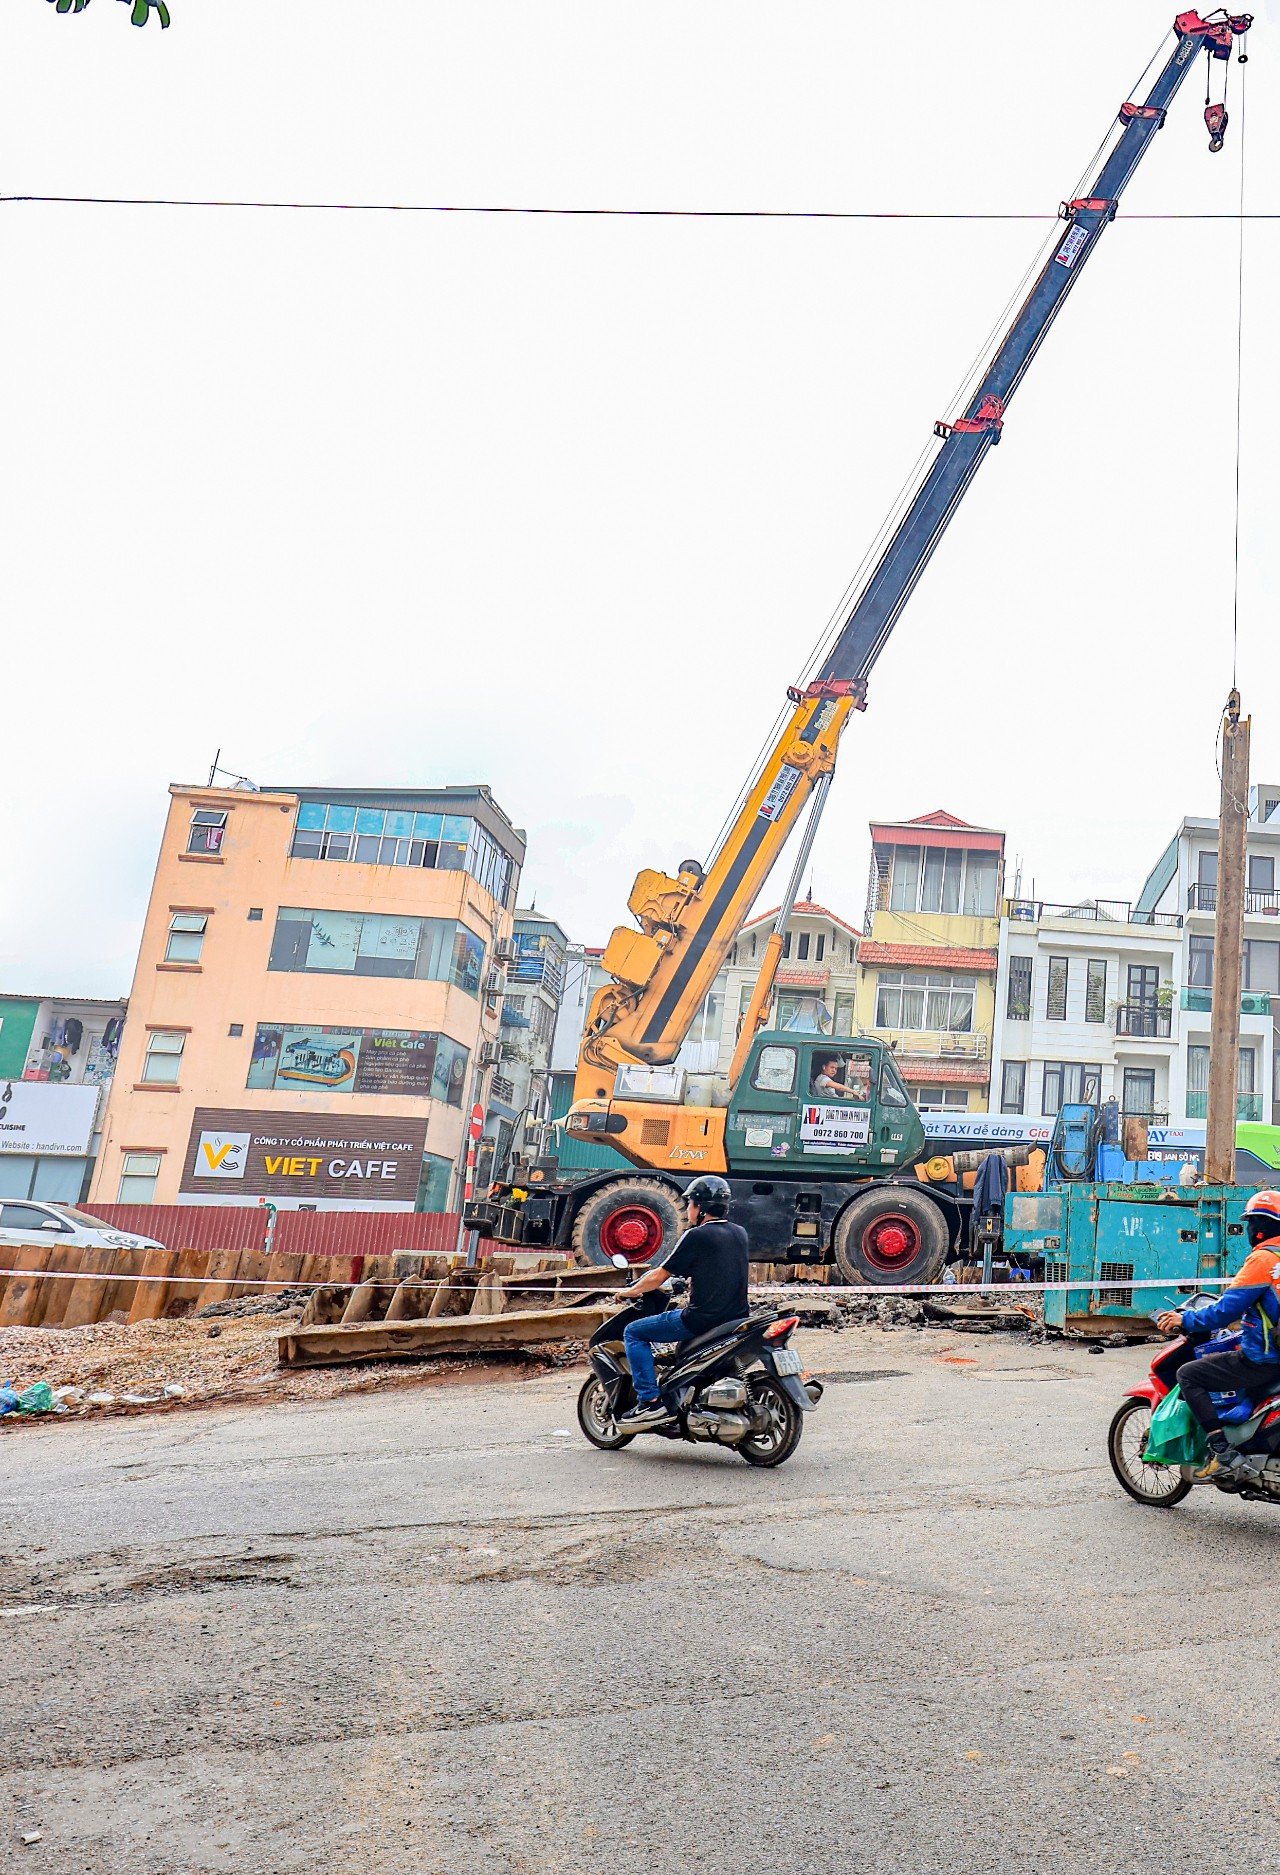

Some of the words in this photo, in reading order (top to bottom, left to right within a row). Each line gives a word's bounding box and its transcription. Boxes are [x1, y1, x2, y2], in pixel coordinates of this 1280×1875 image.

[400, 1040, 425, 1050] Cafe
[813, 1128, 832, 1138] 0972
[834, 1130, 848, 1139] 860
[850, 1131, 864, 1140] 700
[943, 1124, 970, 1135] TAXI
[973, 1124, 989, 1136] dễ
[991, 1126, 1024, 1139] dàng
[1, 1140, 30, 1149] Website
[35, 1142, 82, 1151] handivn.com
[253, 1136, 277, 1145] CÔNG
[279, 1138, 290, 1146] TY
[327, 1139, 348, 1148] PHÁT
[373, 1142, 392, 1152] VIỆT
[391, 1143, 414, 1151] CAFE
[265, 1156, 323, 1177] VIET
[328, 1159, 398, 1180] CAFE
